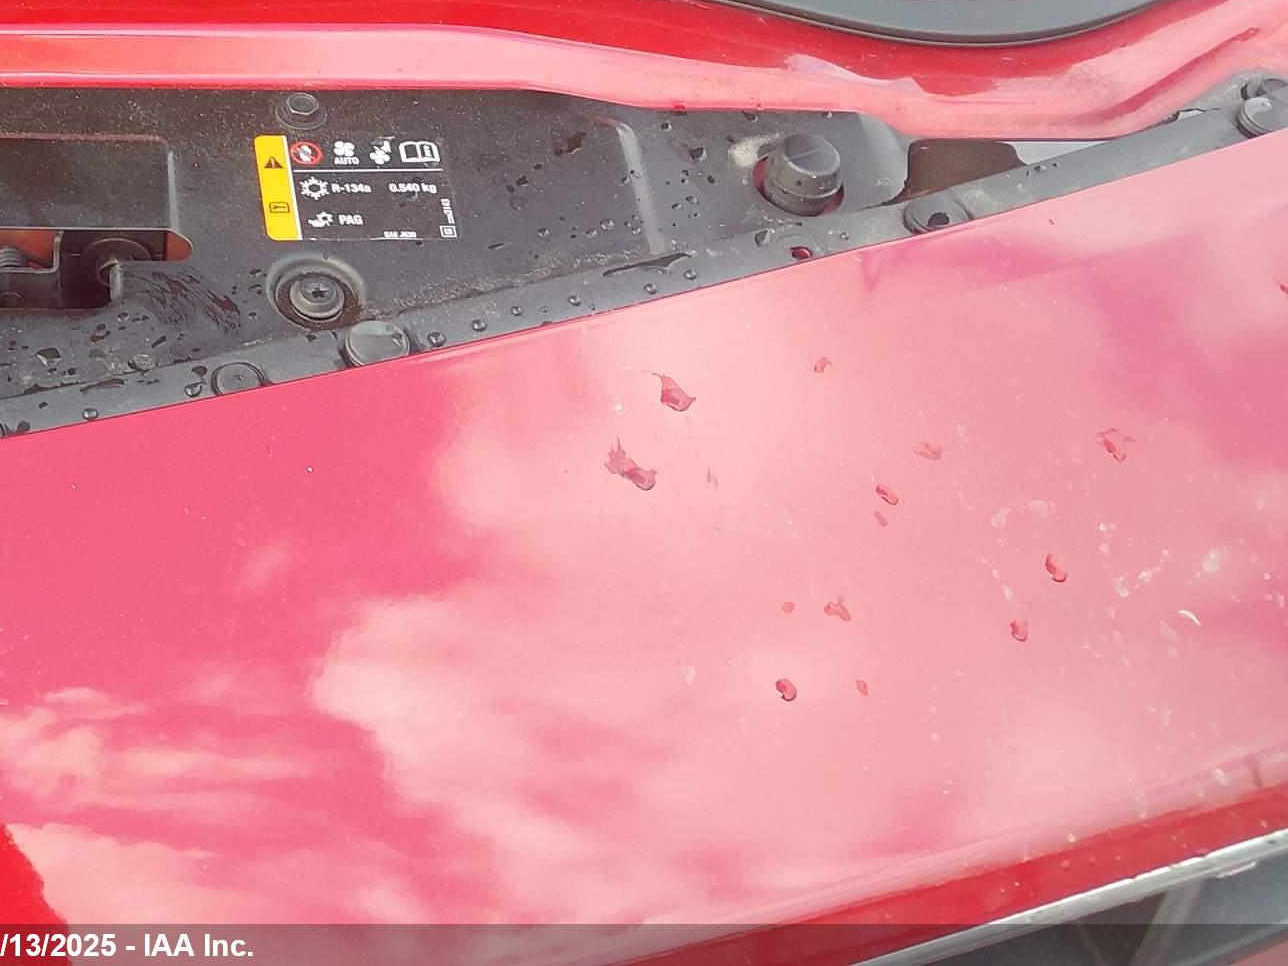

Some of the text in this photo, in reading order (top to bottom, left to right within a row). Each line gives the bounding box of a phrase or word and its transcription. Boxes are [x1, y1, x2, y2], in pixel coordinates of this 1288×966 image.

[334, 156, 360, 165] AUTO
[331, 183, 437, 194] R-134a 0.540 kg
[338, 214, 364, 225] PAG
